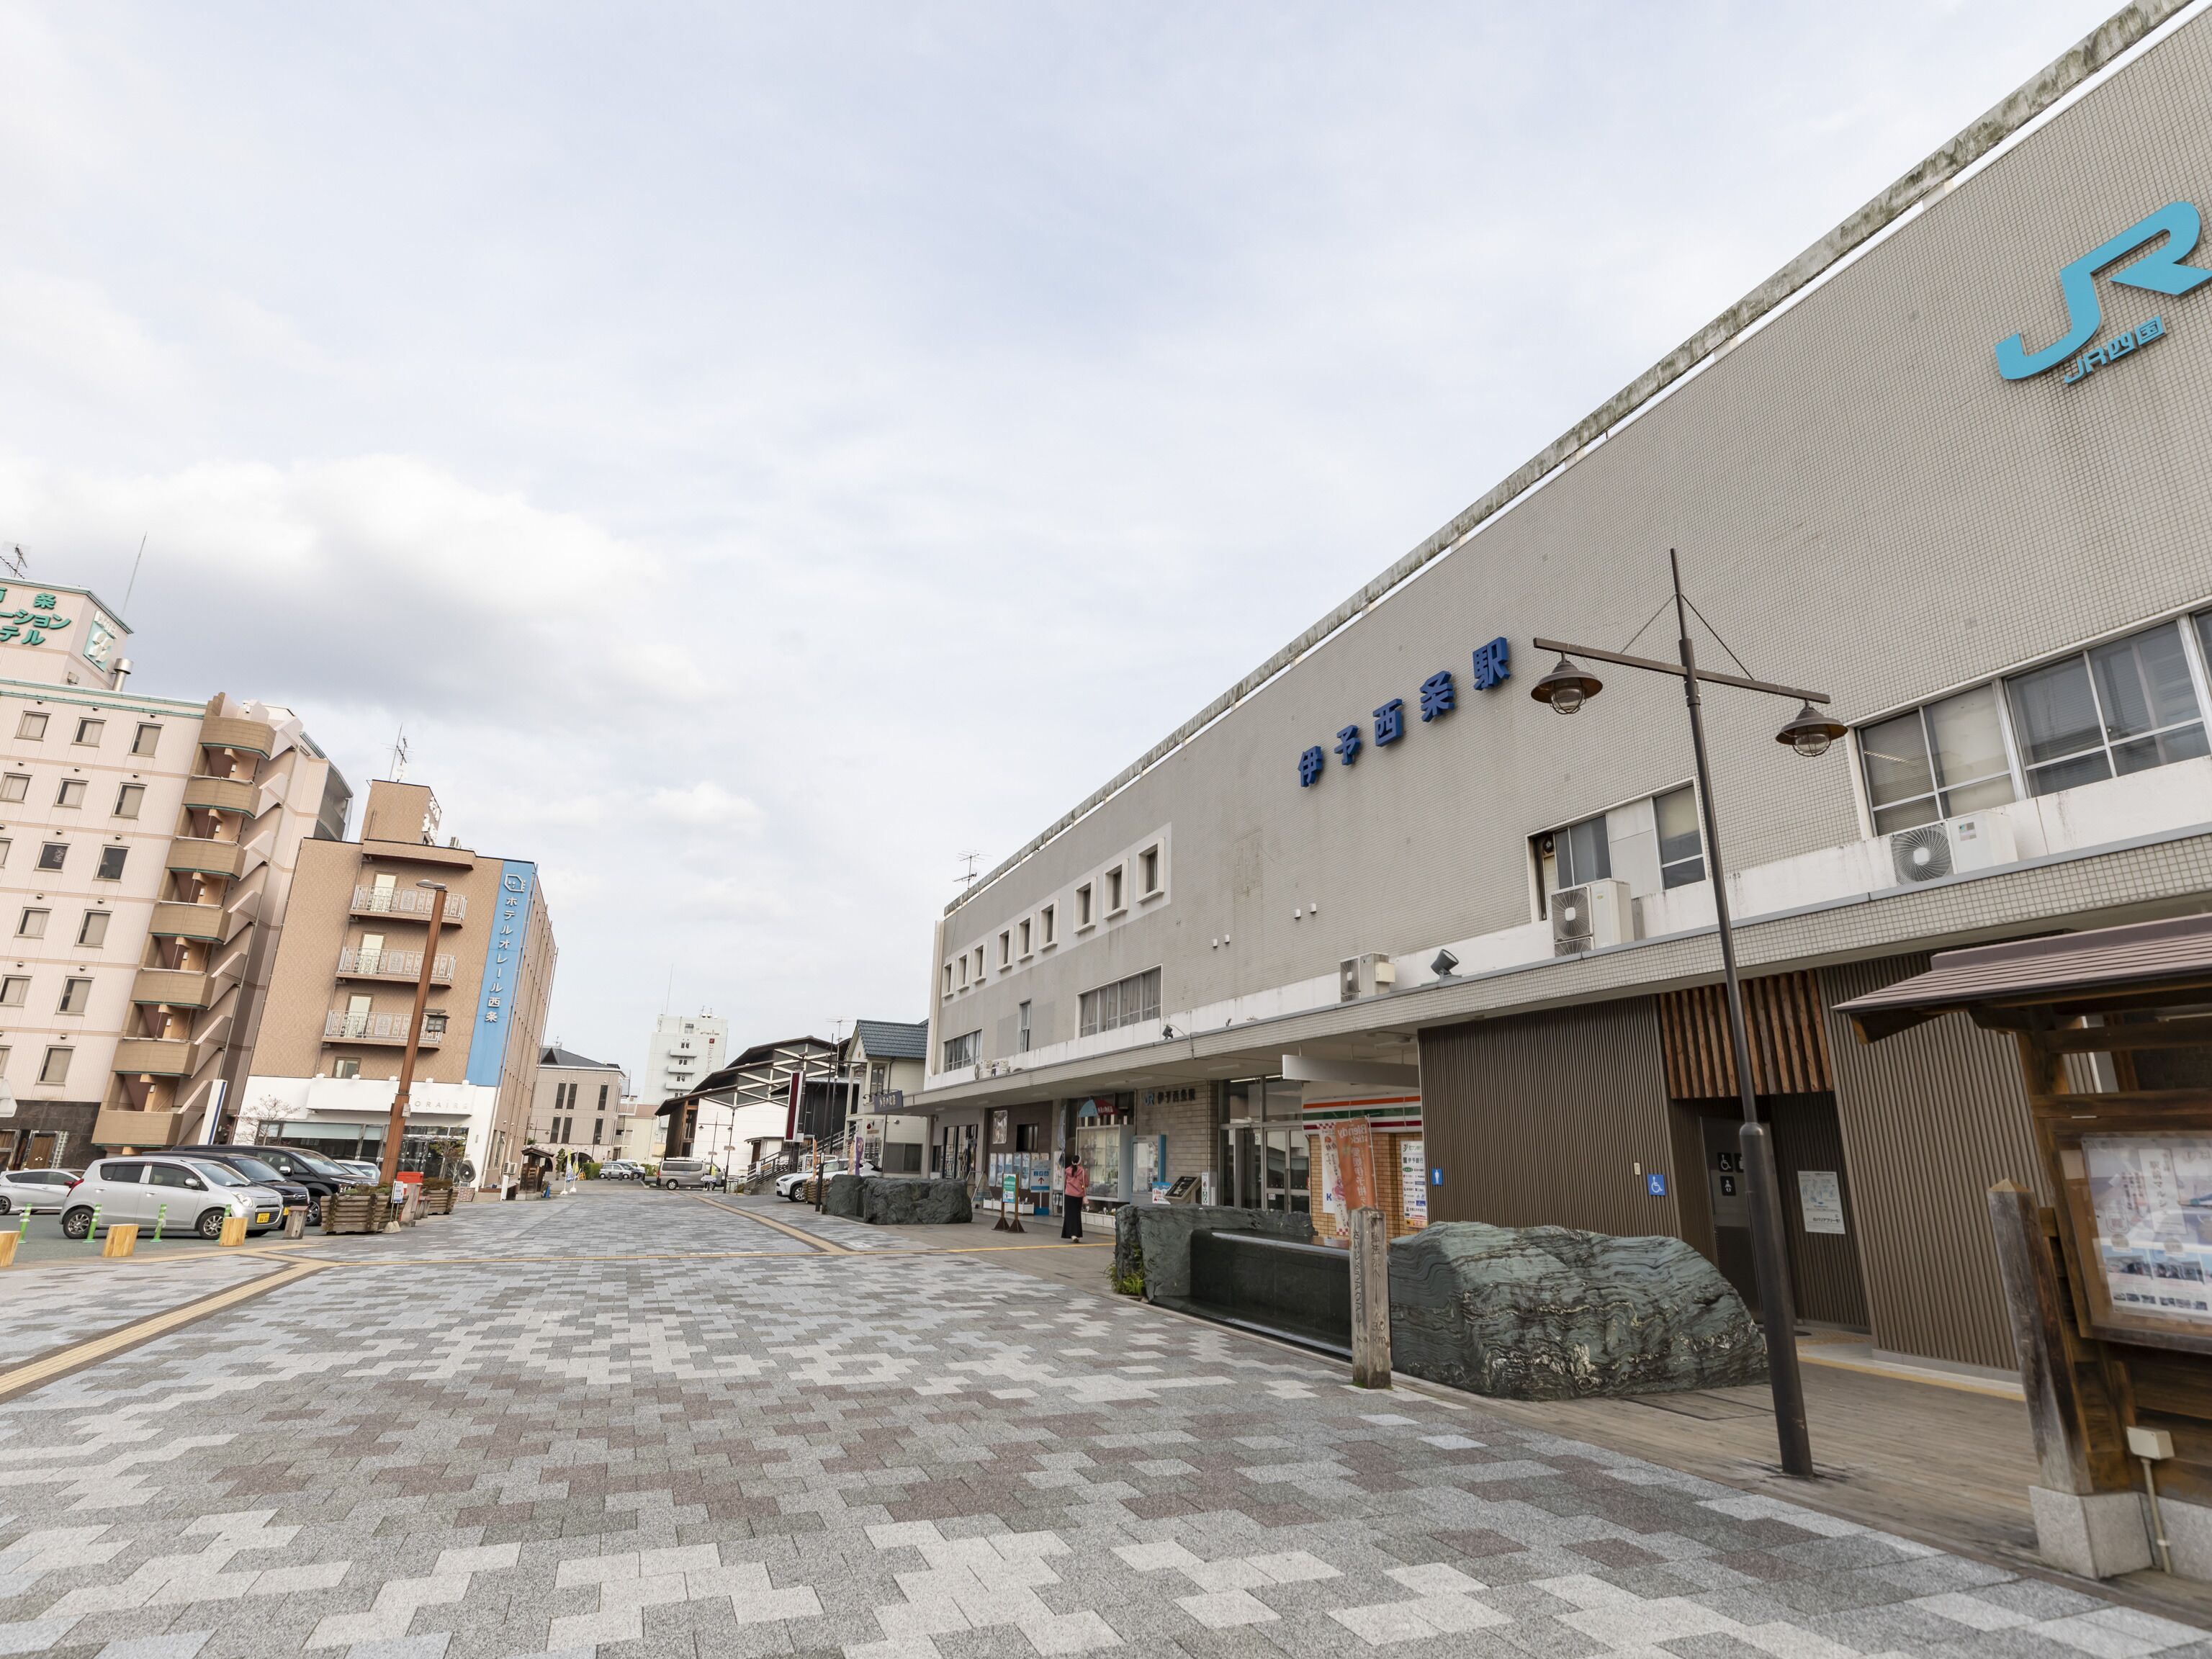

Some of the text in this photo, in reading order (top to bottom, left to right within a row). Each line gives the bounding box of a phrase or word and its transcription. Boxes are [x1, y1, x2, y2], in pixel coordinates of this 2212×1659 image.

[1995, 201, 2212, 380] JR
[2064, 315, 2167, 385] JR四国
[1298, 637, 1511, 788] 伊予西条駅
[485, 896, 518, 1022] ホテルオレール西条
